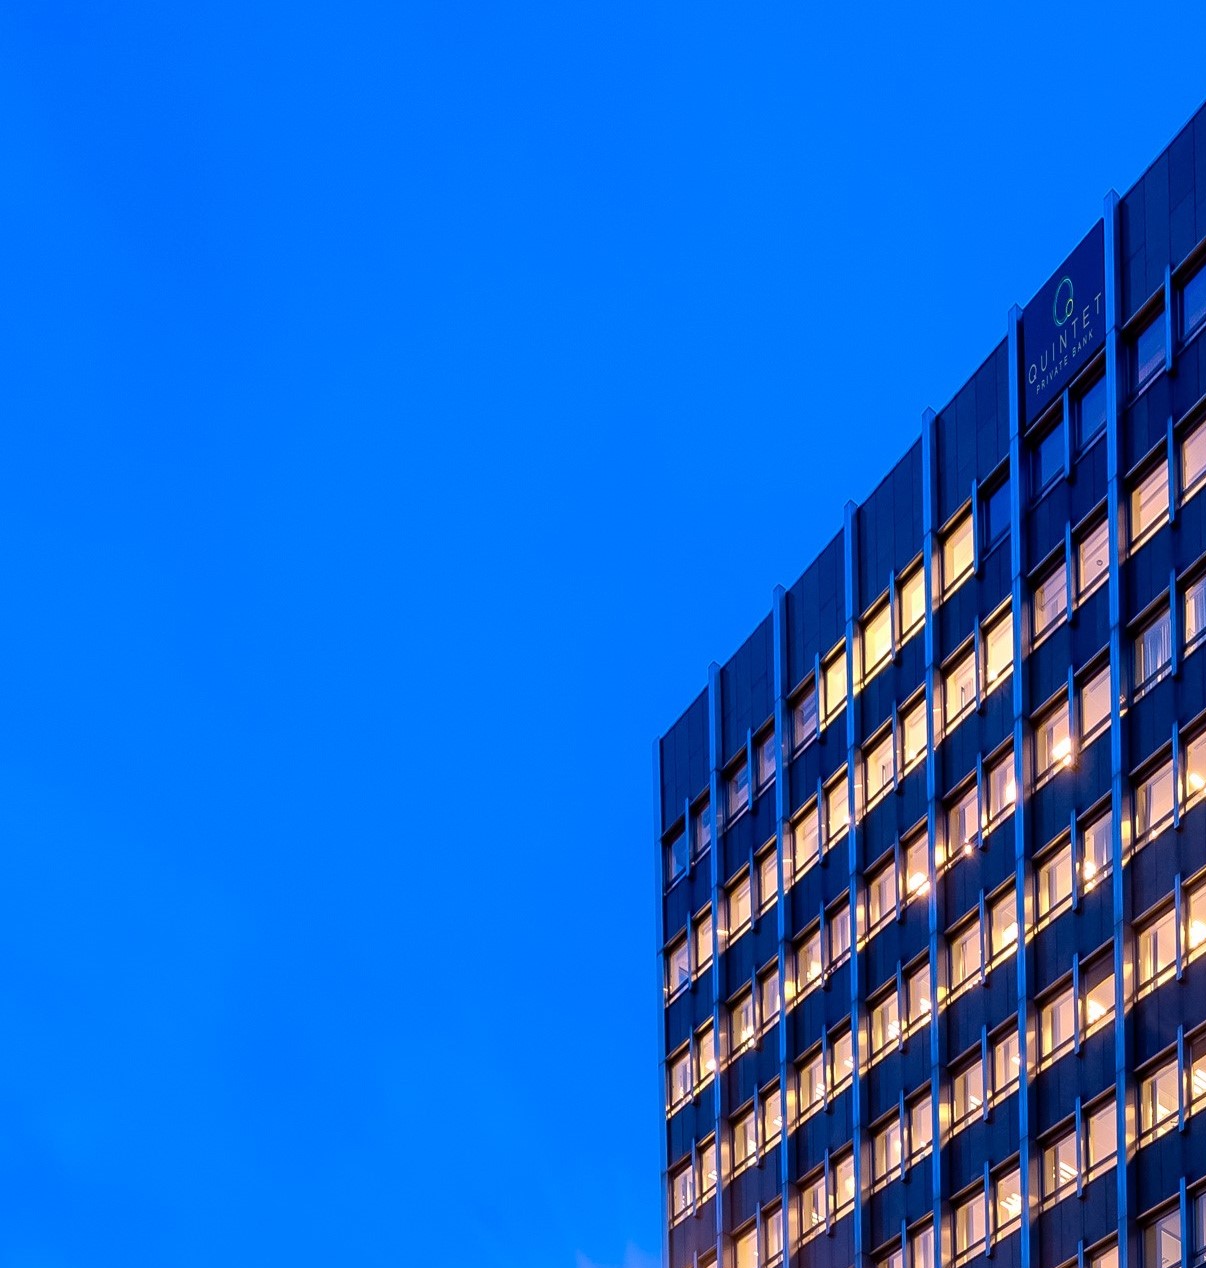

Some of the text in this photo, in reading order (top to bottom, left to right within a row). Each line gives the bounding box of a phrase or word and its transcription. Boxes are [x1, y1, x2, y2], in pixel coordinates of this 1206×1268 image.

[1028, 292, 1102, 384] QUINTET
[1036, 328, 1094, 394] PRIVATE BANK
